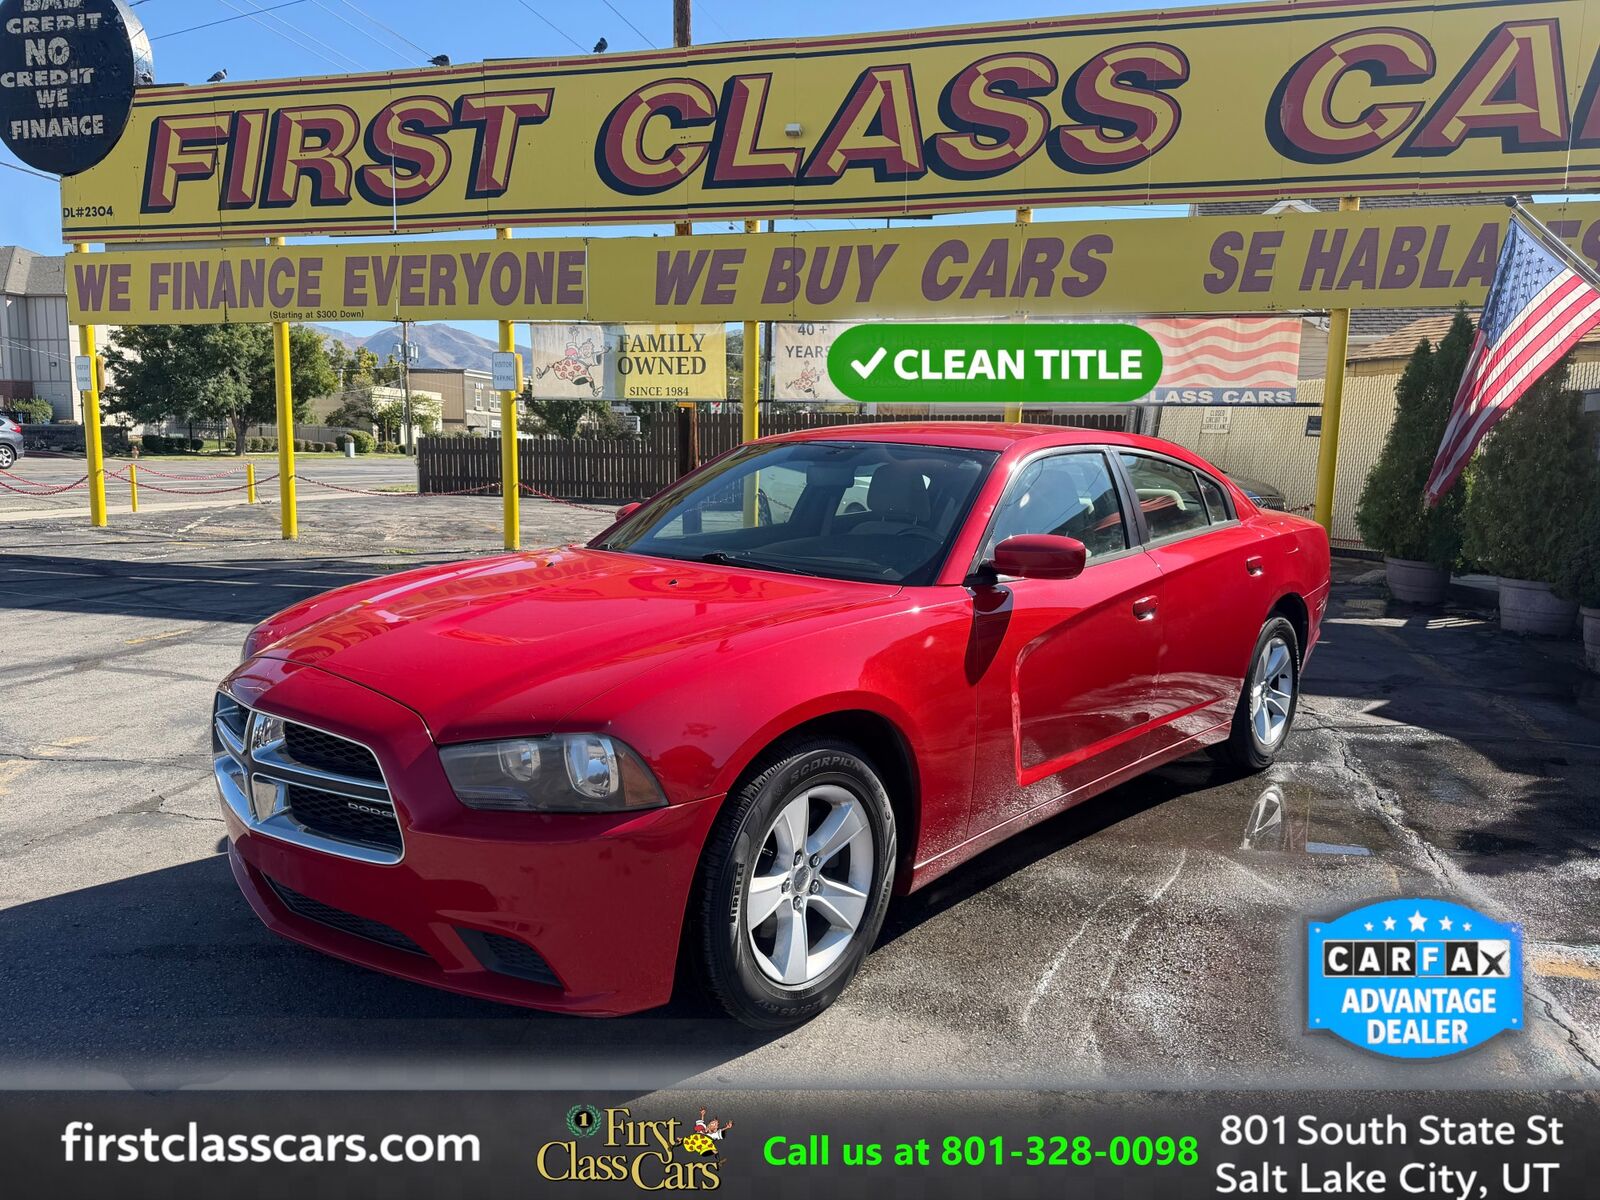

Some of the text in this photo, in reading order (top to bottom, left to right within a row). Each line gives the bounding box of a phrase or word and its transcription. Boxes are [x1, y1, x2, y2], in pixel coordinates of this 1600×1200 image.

[6, 13, 102, 34] CREDIT
[25, 37, 70, 67] NO
[0, 68, 94, 88] CREDIT
[36, 88, 69, 109] WE
[141, 17, 1600, 214] FIRST CLASS CA
[10, 114, 104, 140] FINANCE
[62, 205, 114, 218] DL#2304
[1203, 230, 1285, 295] SE
[1298, 222, 1500, 291] HABLA
[654, 234, 1113, 305] WE BUY CARS
[73, 251, 586, 311] WE FINANCE EVERYONE
[269, 309, 364, 320] (Starting at $300 Down)
[797, 322, 815, 336] 40
[617, 333, 707, 353] FAMILY
[617, 356, 707, 375] OWNED
[629, 385, 690, 396] SINCE 1984
[1143, 390, 1292, 404] LASS CARS
[790, 756, 863, 784] SCORPION
